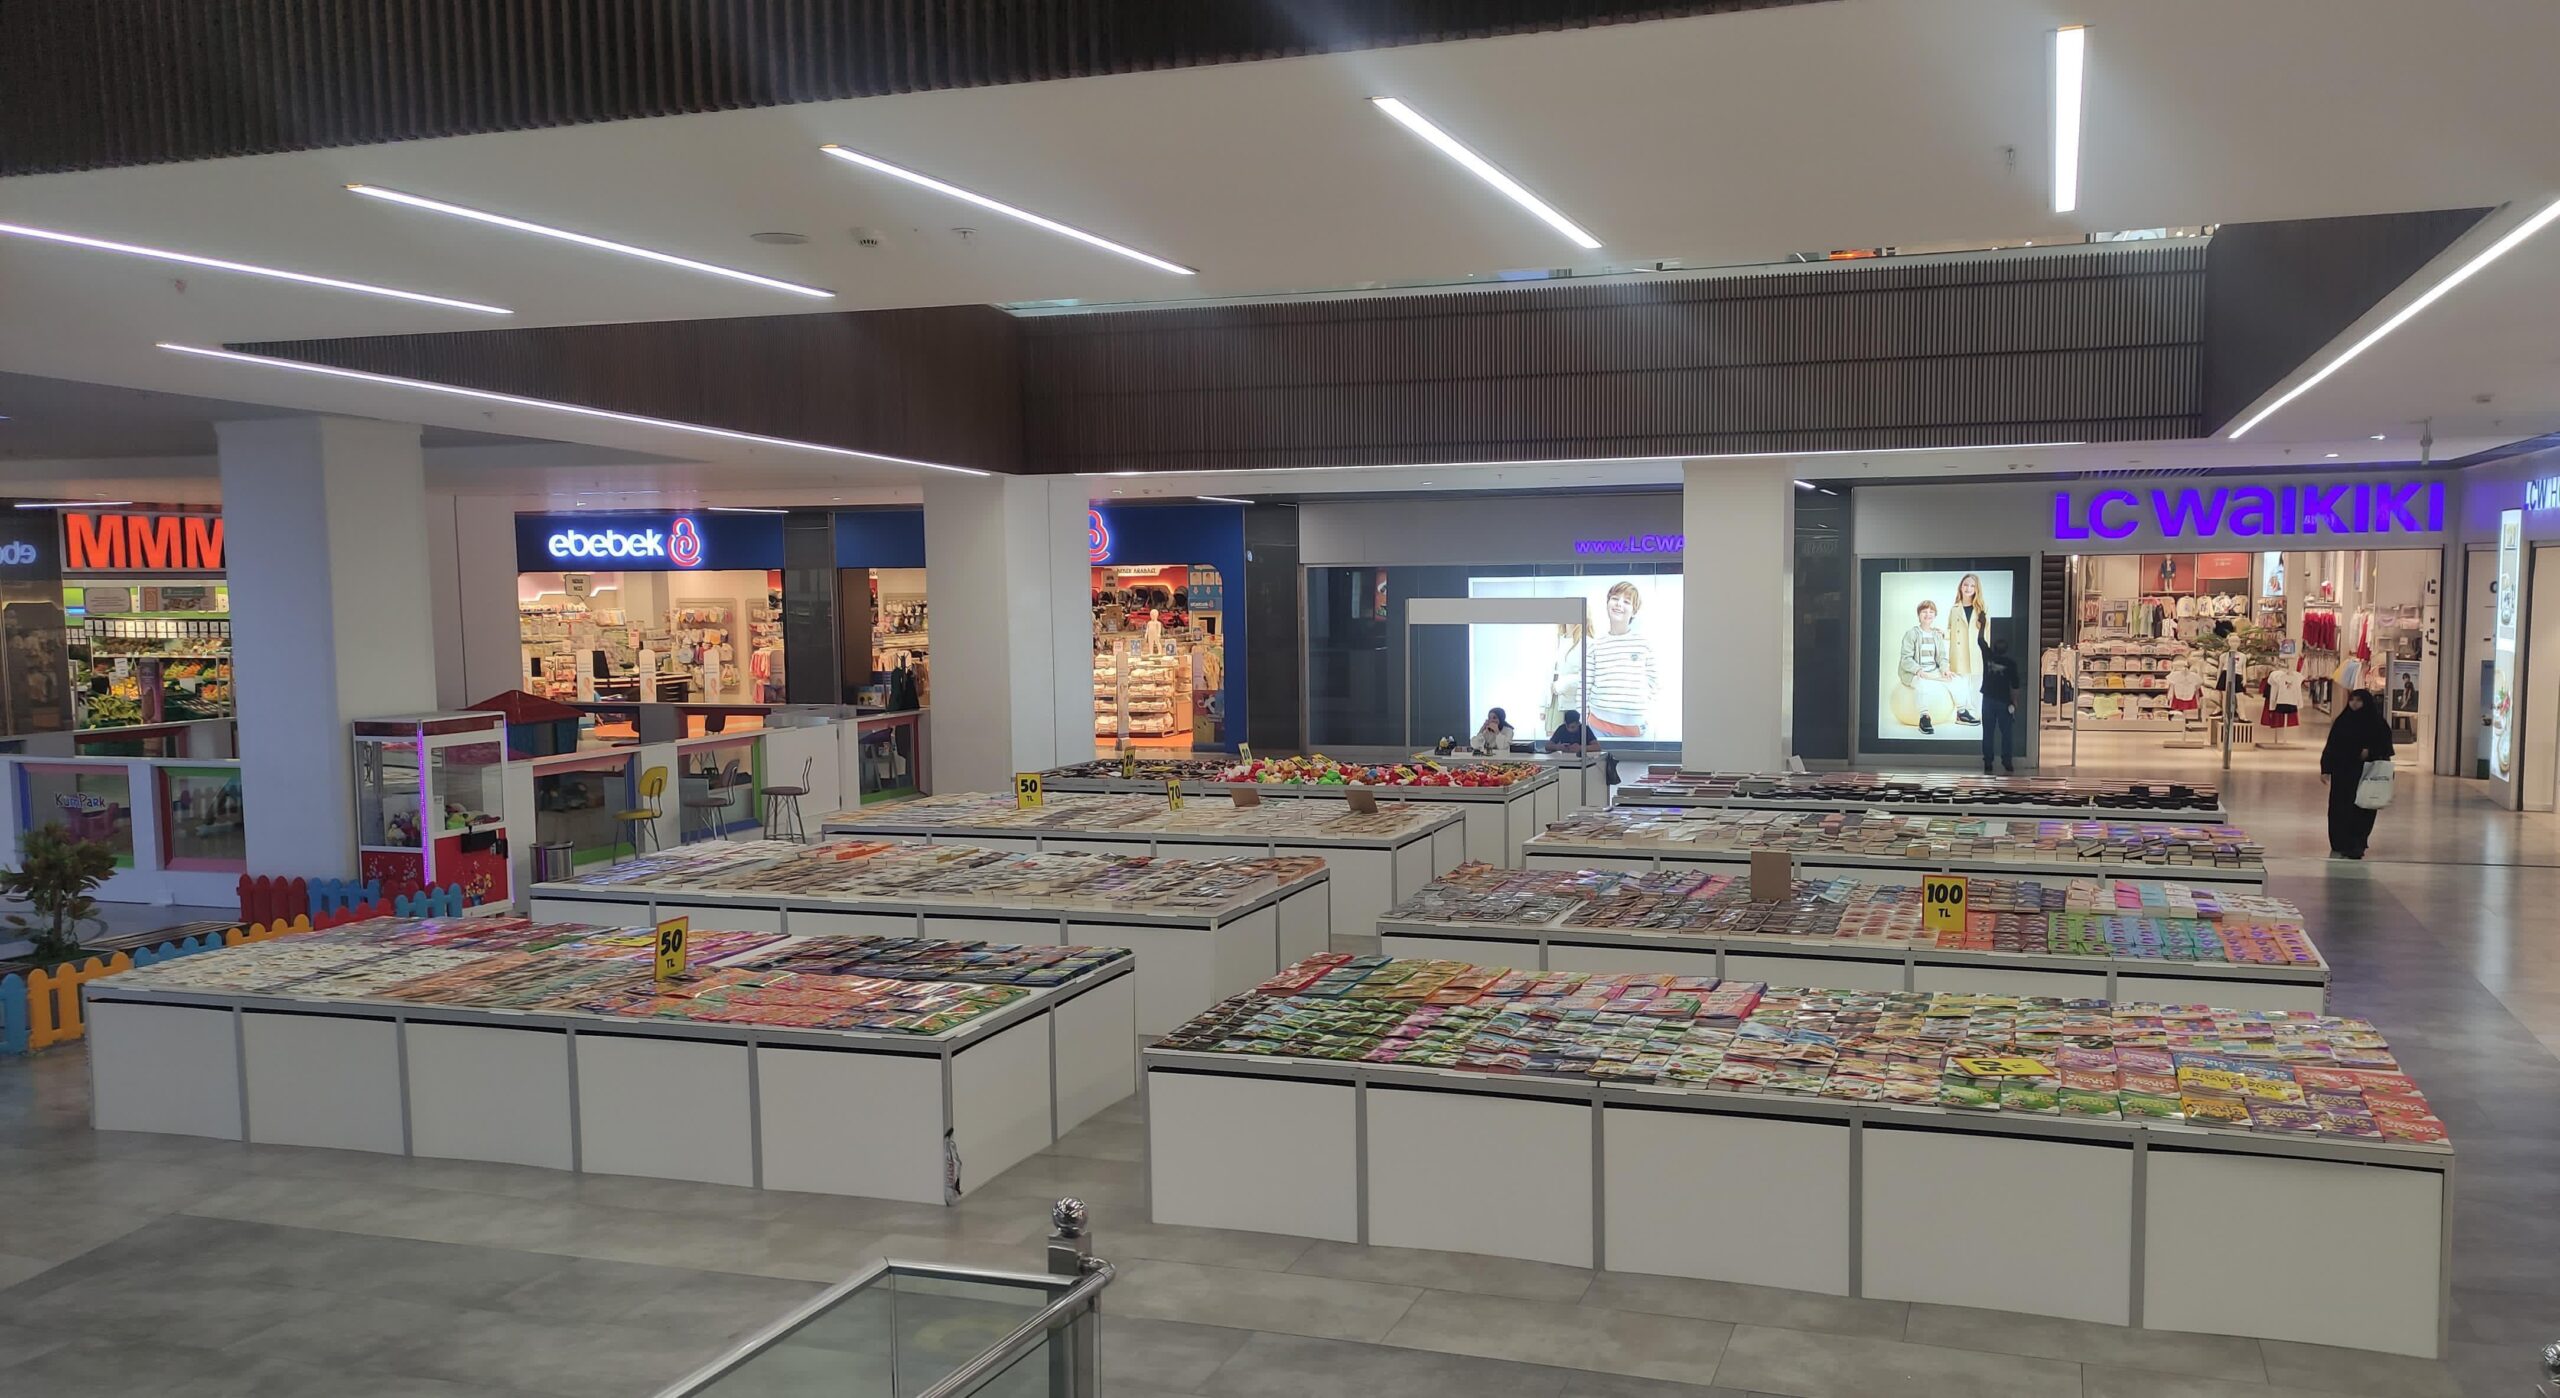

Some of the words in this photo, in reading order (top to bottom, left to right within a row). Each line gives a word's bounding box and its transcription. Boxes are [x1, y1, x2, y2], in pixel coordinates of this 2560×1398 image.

[2524, 479, 2549, 510] LCW
[2551, 476, 2560, 508] H
[2055, 489, 2140, 539] LC
[66, 513, 224, 569] MMM
[548, 529, 665, 557] ebebek
[1020, 779, 1038, 793] 50
[1170, 785, 1181, 800] 70
[1927, 883, 1963, 904] 100
[1938, 908, 1951, 918] TL
[660, 929, 683, 956] 50
[666, 958, 675, 968] TL
[1972, 1060, 2013, 1072] 50
